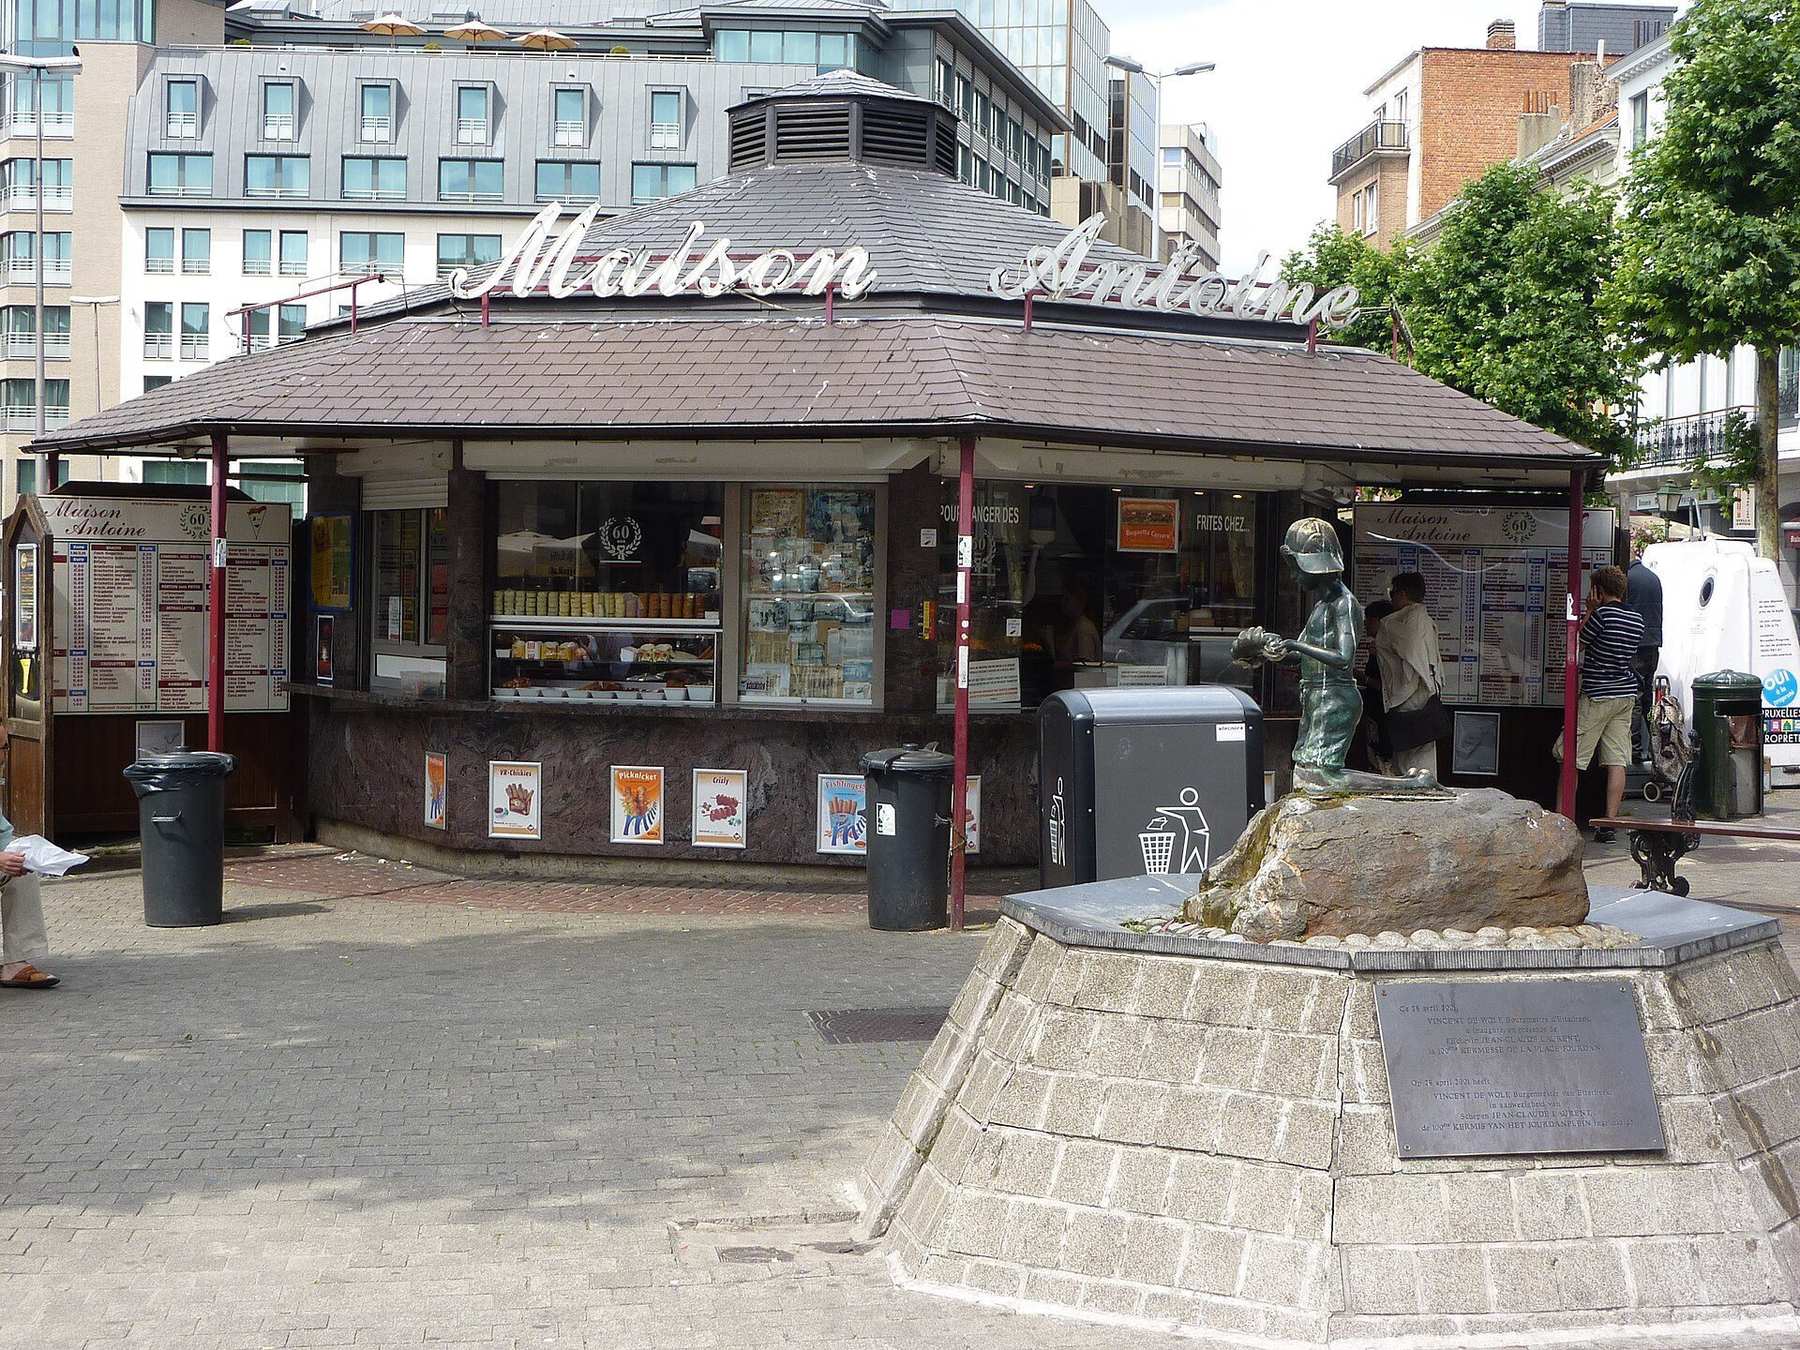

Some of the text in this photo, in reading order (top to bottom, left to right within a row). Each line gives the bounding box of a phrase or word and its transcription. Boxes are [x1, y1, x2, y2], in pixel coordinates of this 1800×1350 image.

[449, 201, 1360, 328] Maison Antoine
[45, 500, 121, 519] Maison
[1002, 506, 1019, 524] DES
[1377, 508, 1448, 525] Maison
[65, 518, 146, 536] Antoine
[189, 513, 205, 525] 60
[1196, 514, 1224, 531] FRITES
[1511, 519, 1527, 531] 60
[612, 525, 629, 539] 60
[1396, 525, 1471, 542] Antoine
[1763, 671, 1790, 690] OUI
[619, 771, 657, 782] Picknicker
[1433, 1092, 1471, 1100] VINCENT
[1453, 1122, 1486, 1131] KERMIS
[1487, 1121, 1505, 1129] VAN
[1508, 1121, 1525, 1129] HET
